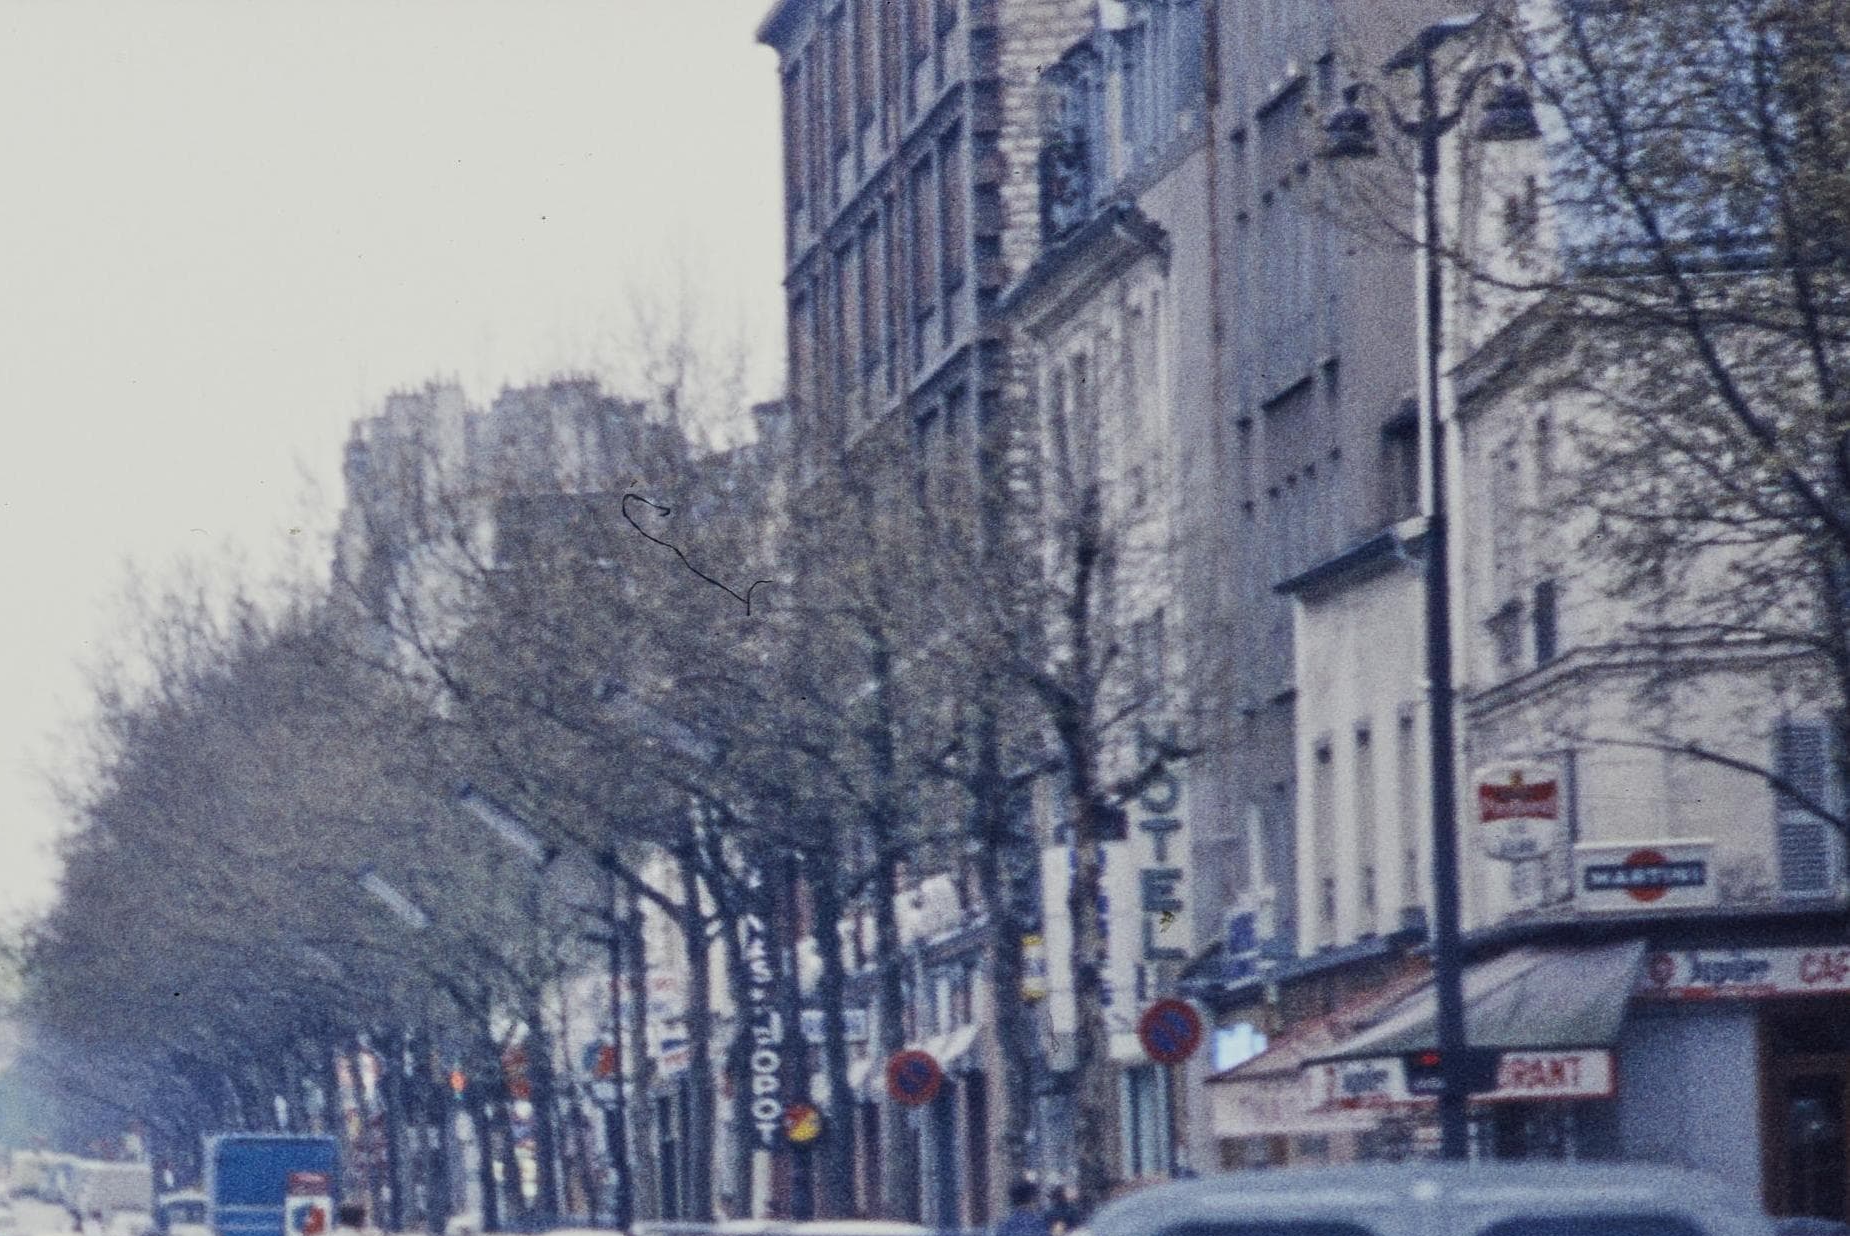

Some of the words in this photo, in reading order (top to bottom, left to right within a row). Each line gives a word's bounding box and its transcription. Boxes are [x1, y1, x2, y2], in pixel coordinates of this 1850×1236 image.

[1136, 721, 1188, 961] HOTEL
[1590, 865, 1701, 886] MARTINI
[1500, 1056, 1583, 1090] RANT
